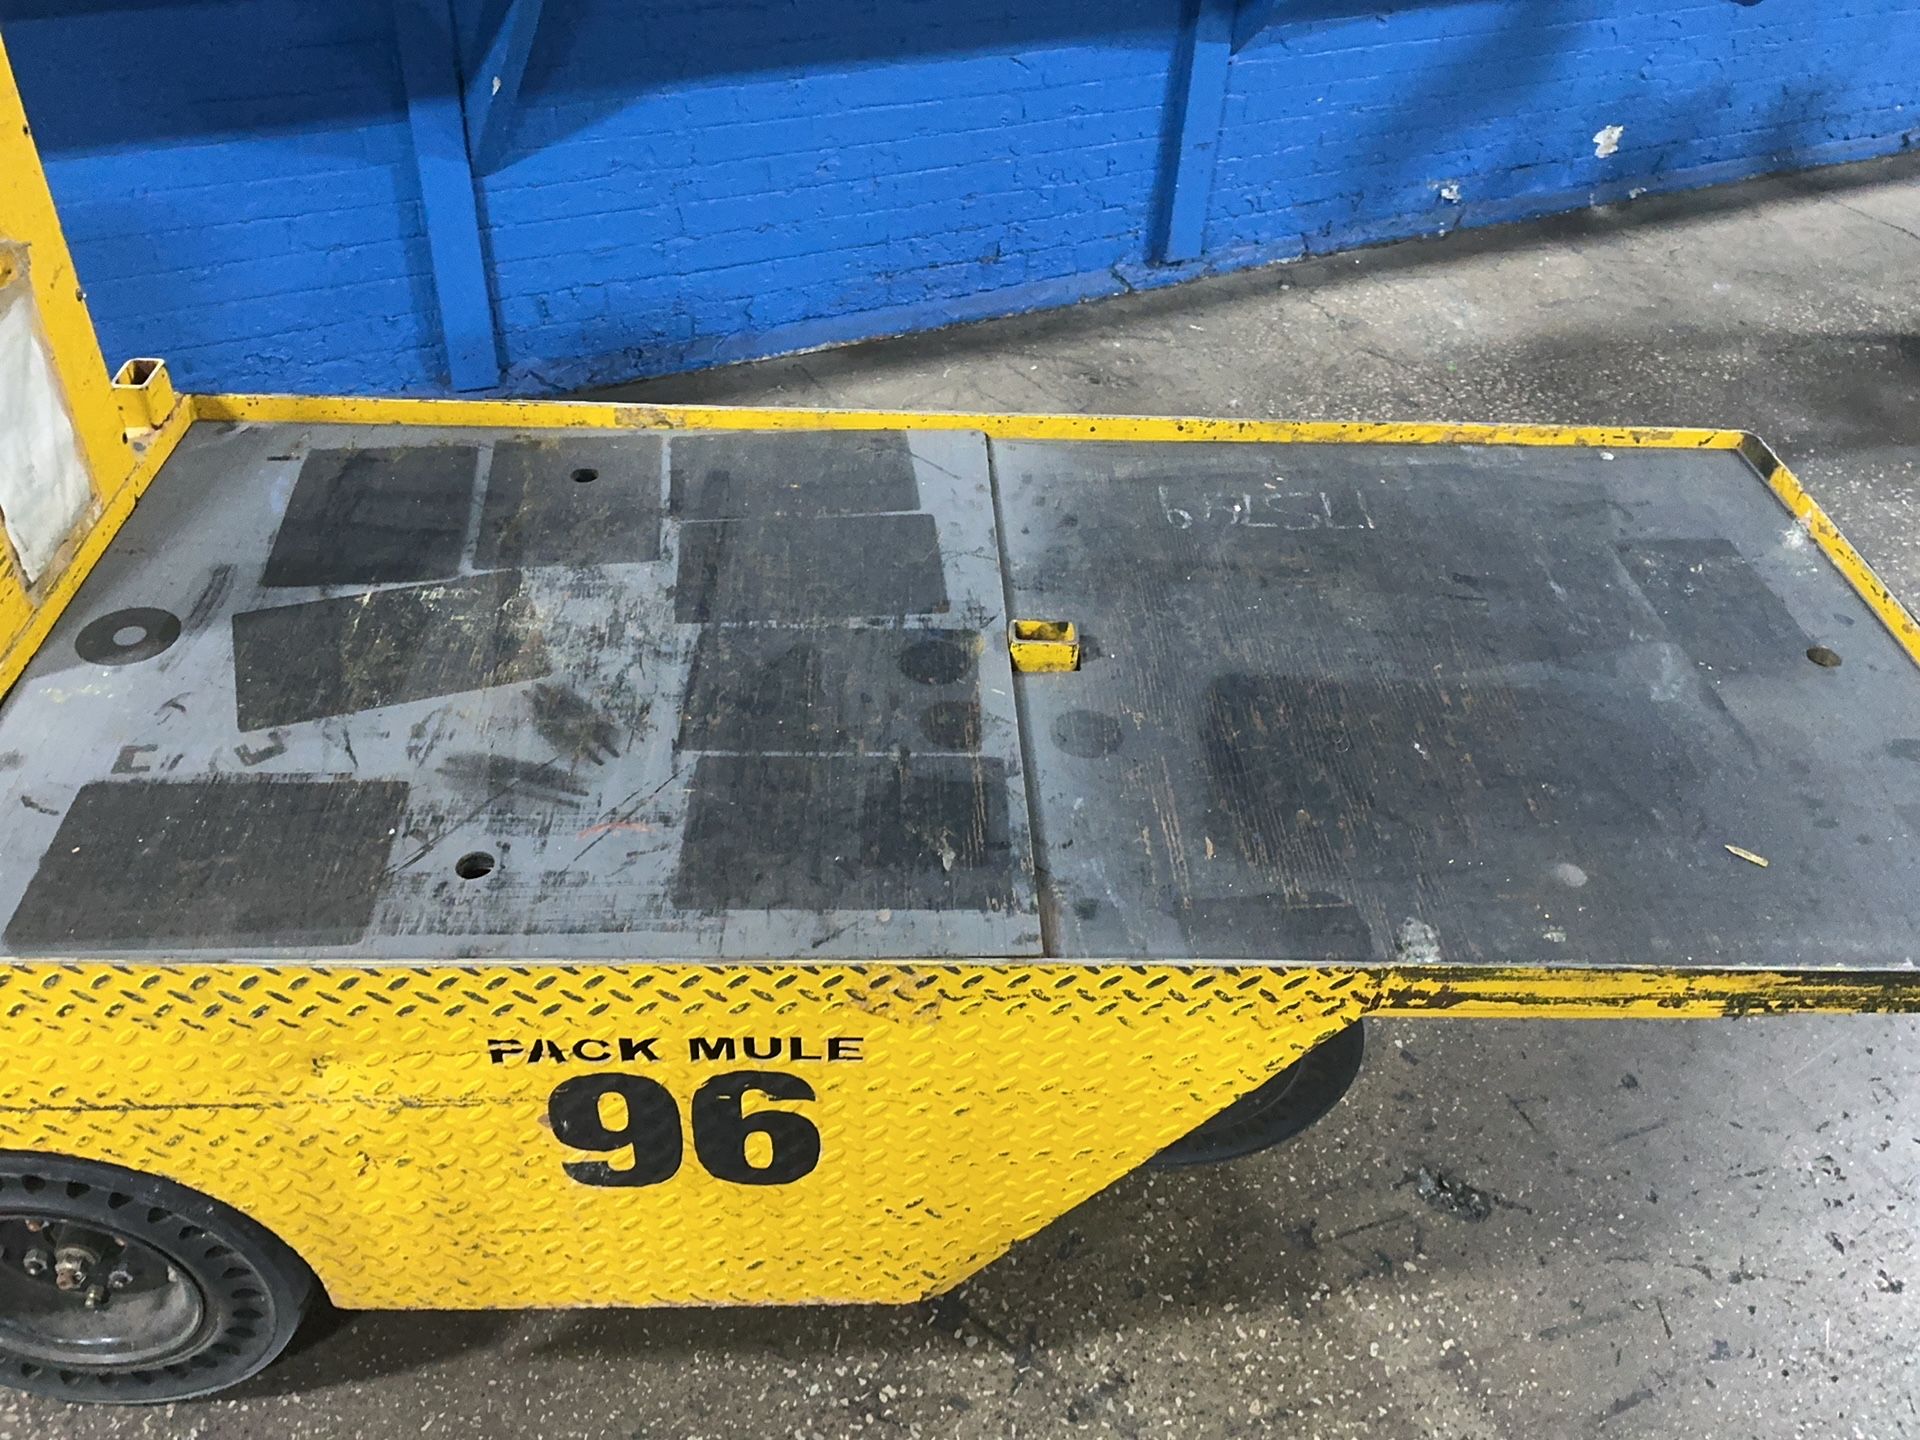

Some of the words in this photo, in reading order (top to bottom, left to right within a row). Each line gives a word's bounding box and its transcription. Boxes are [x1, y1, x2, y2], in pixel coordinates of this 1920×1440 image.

[487, 1037, 662, 1064] PACK
[688, 1036, 865, 1063] MULE
[547, 1070, 821, 1188] 96
